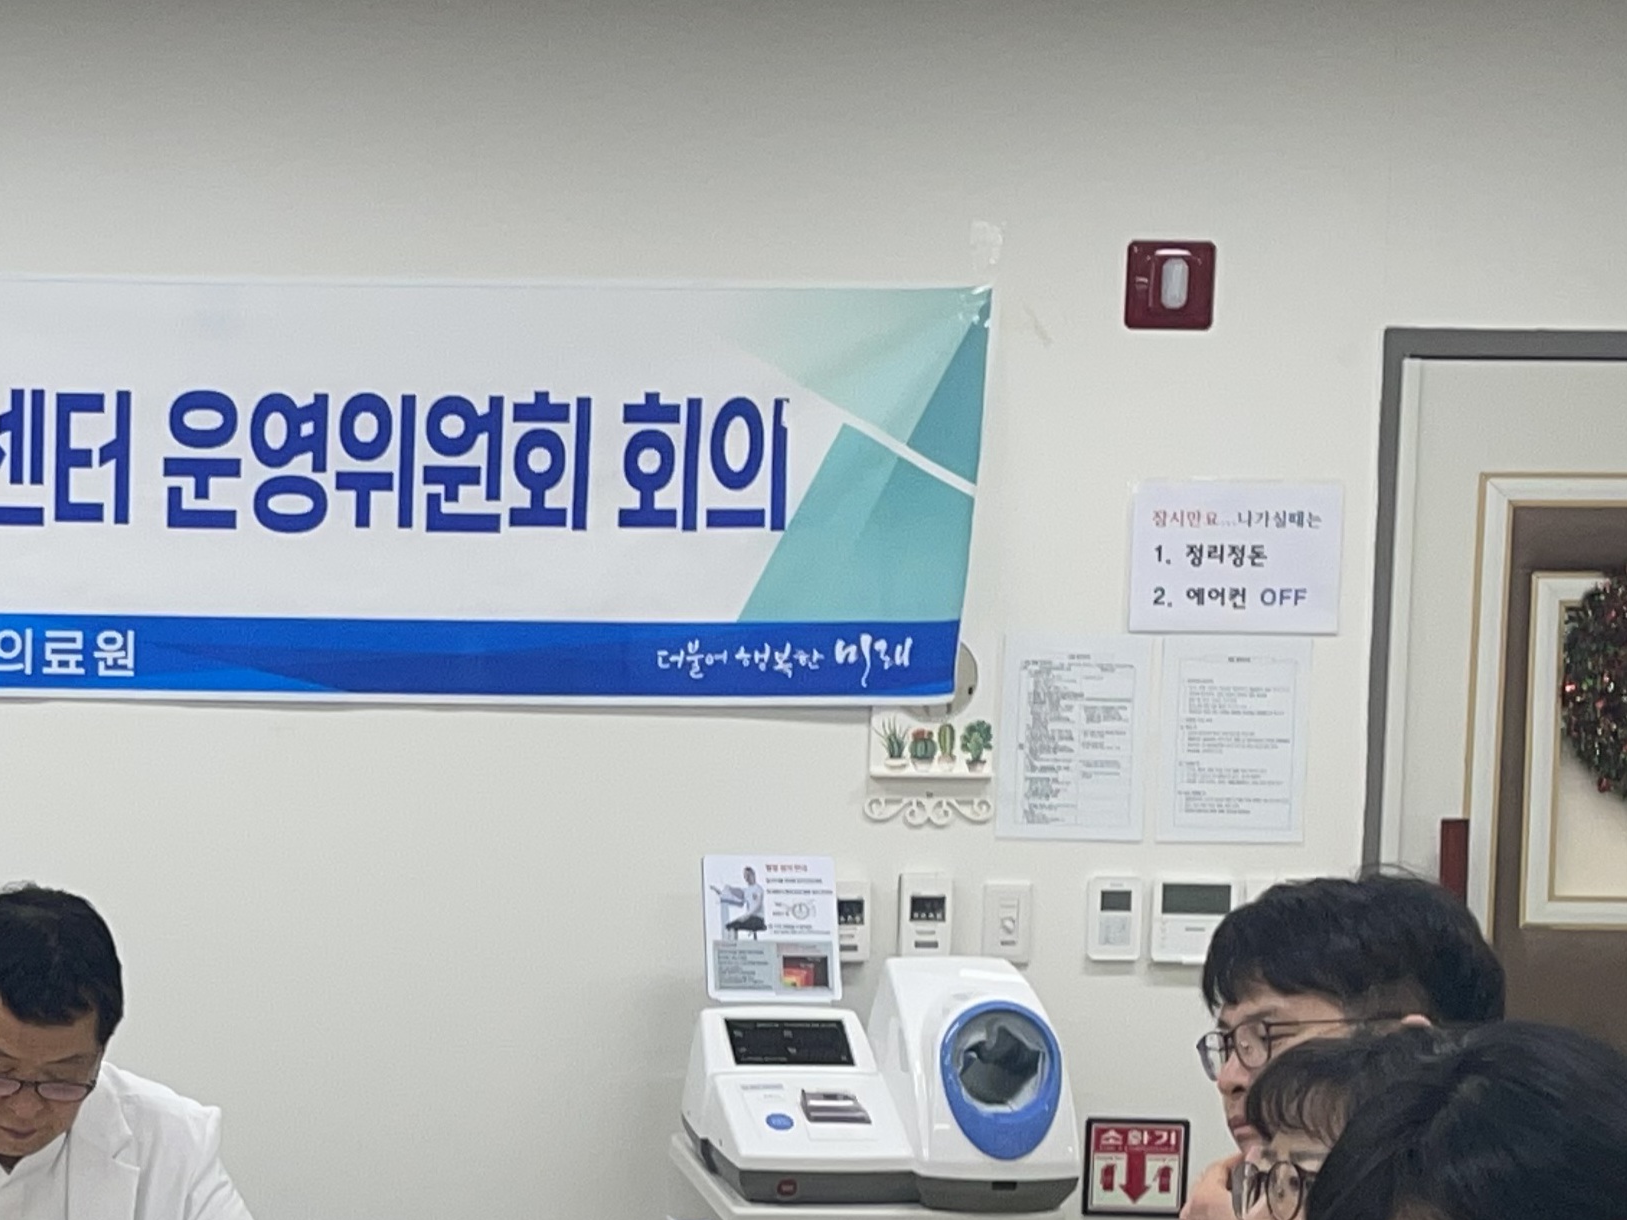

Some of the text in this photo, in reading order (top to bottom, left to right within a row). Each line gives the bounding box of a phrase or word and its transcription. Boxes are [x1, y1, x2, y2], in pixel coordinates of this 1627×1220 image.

[163, 390, 591, 533] 운영위원회
[618, 391, 789, 533] 회의
[1154, 543, 1268, 568] 1. 정리정돈
[1153, 586, 1308, 610] 2. 에어컨 OFF
[657, 633, 913, 688] 더불어 행복한 미래
[1100, 1129, 1176, 1146] 소화기
